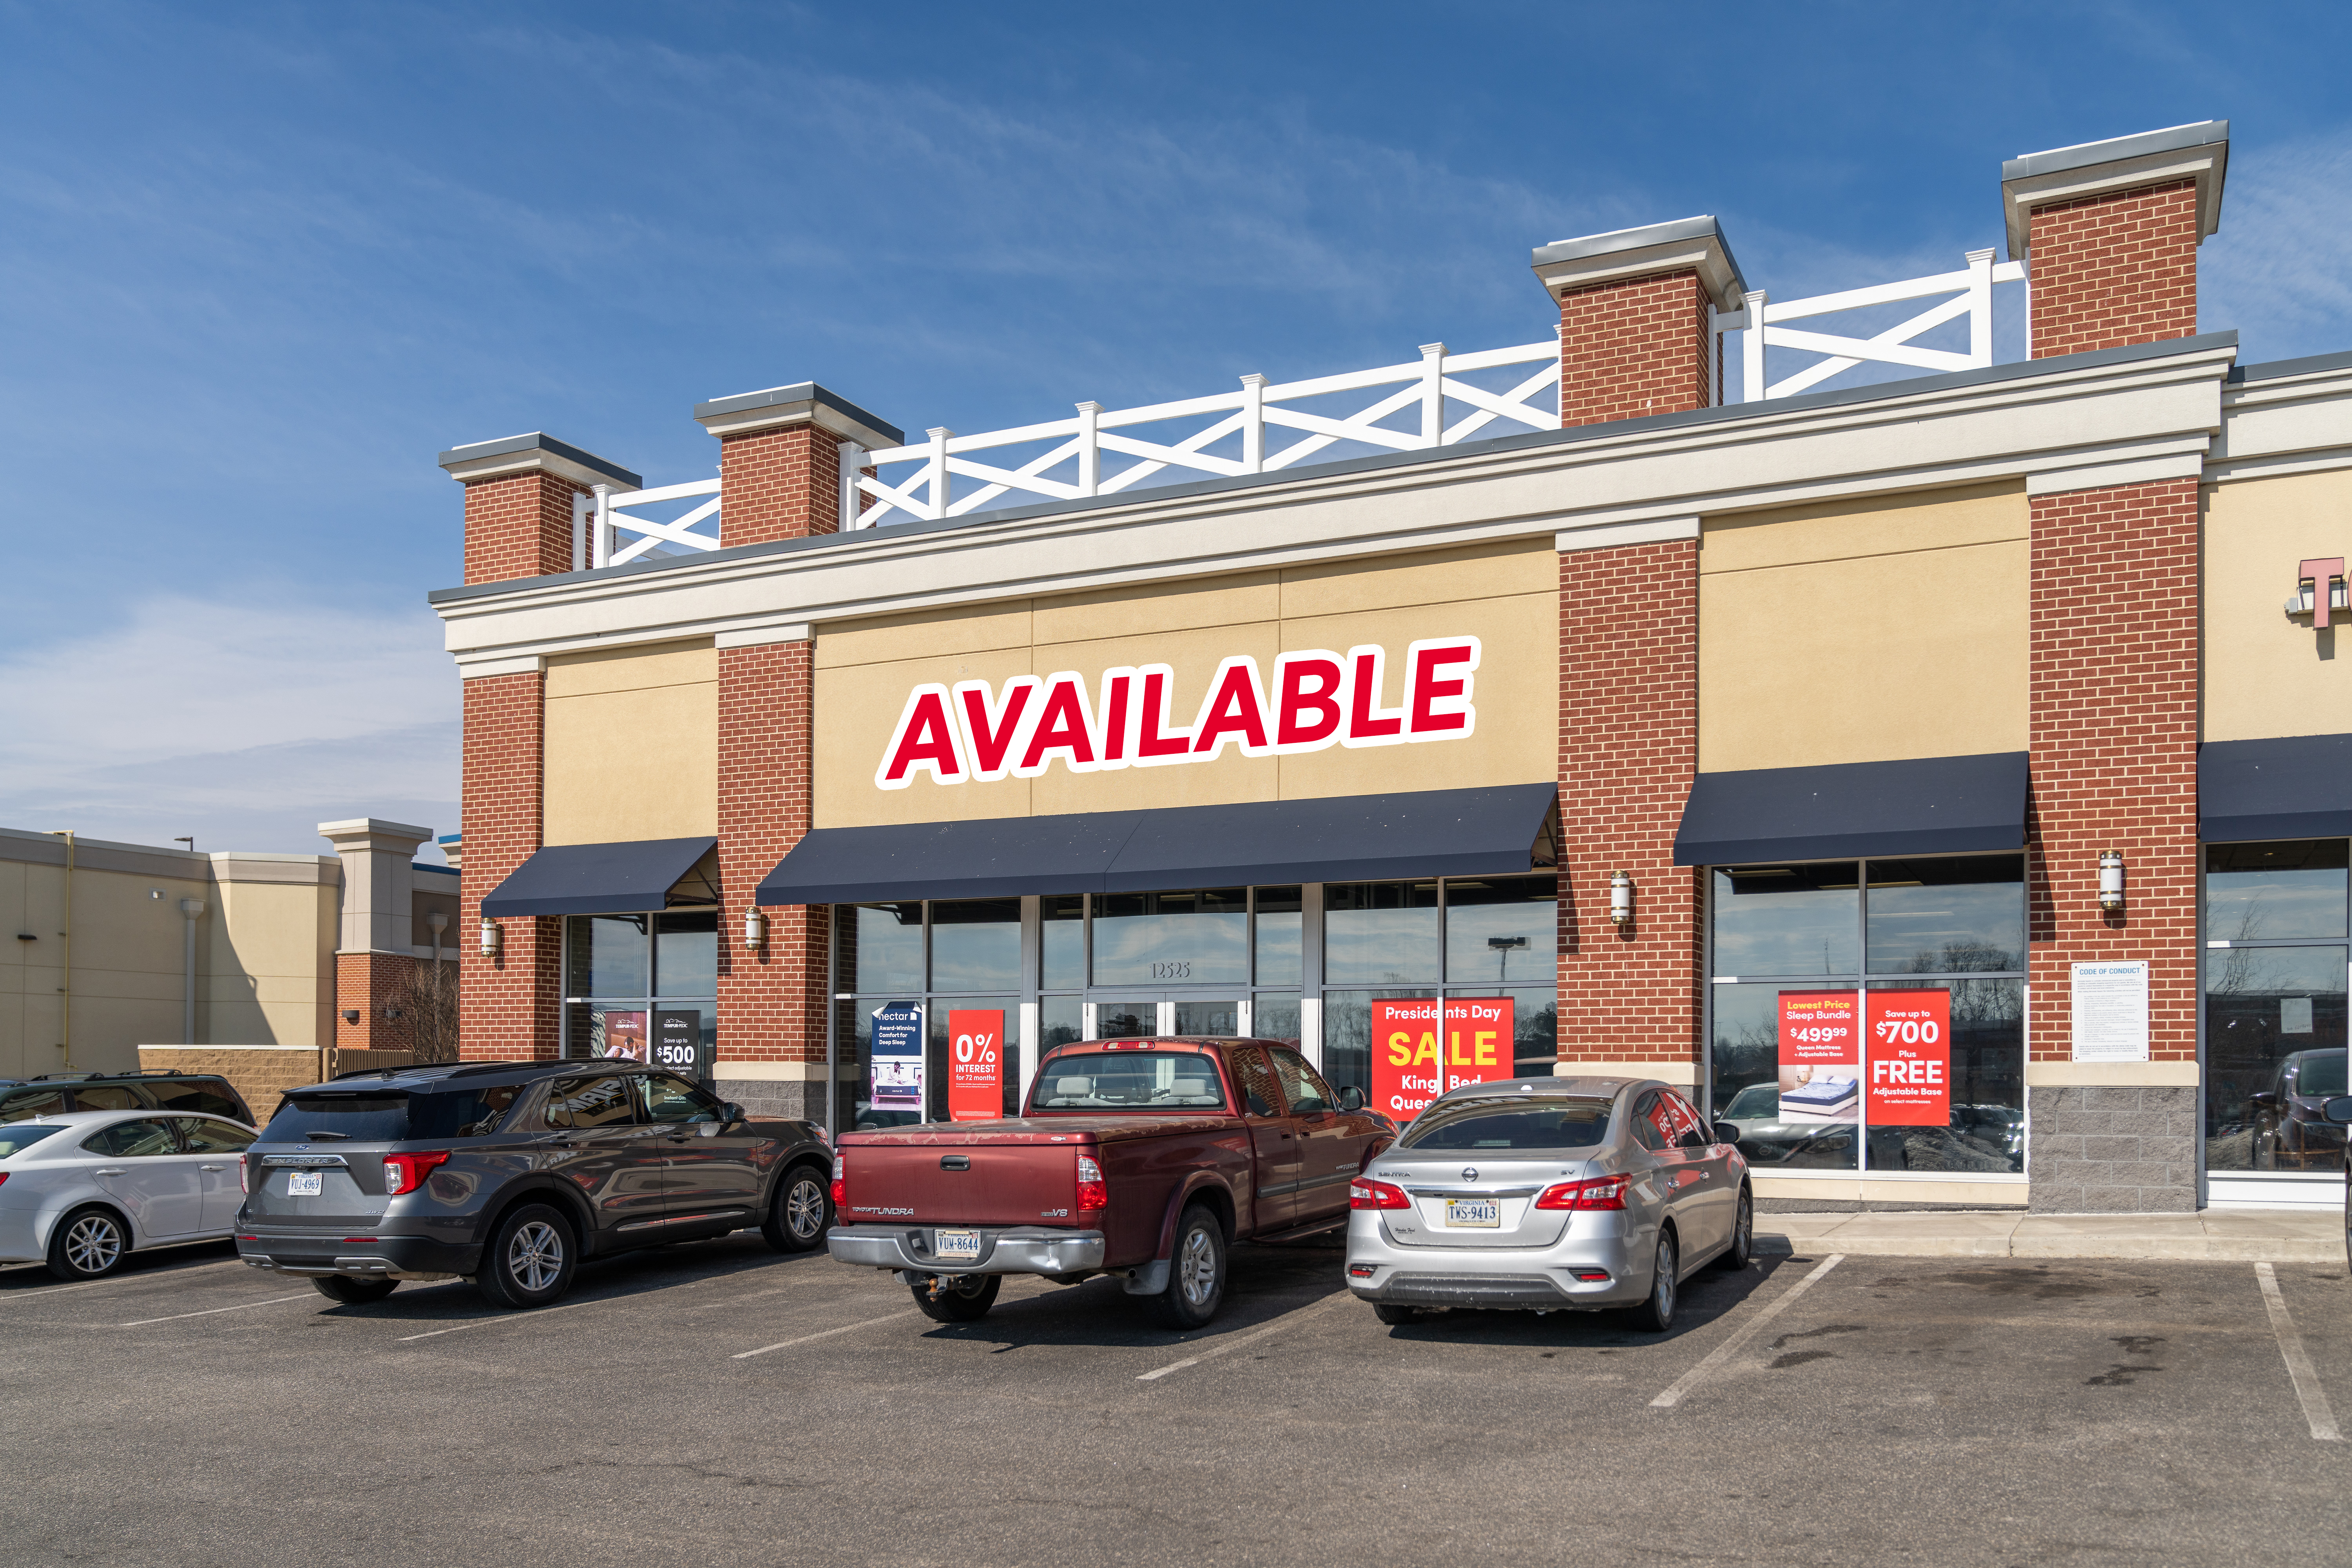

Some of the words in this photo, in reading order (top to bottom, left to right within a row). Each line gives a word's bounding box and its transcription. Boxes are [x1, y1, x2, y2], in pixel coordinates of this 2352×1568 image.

[2299, 557, 2352, 631] T
[1148, 962, 1190, 978] 12525
[1824, 1000, 1850, 1009] Price
[1385, 1006, 1467, 1019] Presidents
[1472, 1005, 1501, 1021] Day
[1786, 1011, 1814, 1022] Sleep
[1817, 1010, 1851, 1019] Bundle
[1876, 1021, 1939, 1044] $700
[657, 1045, 695, 1063] $500
[956, 1033, 996, 1063] 0%
[1388, 1031, 1497, 1066] SALE
[956, 1064, 996, 1073] INTEREST
[1873, 1060, 1943, 1083] FREE
[1402, 1075, 1437, 1093] King
[1450, 1075, 1481, 1089] Bed
[1873, 1087, 1919, 1097] Adjustable
[1390, 1095, 1434, 1111] Quee
[292, 1179, 319, 1189] VUJ-4969
[1449, 1206, 1495, 1219] TWS-9413
[939, 1237, 978, 1250] VUM-8644
